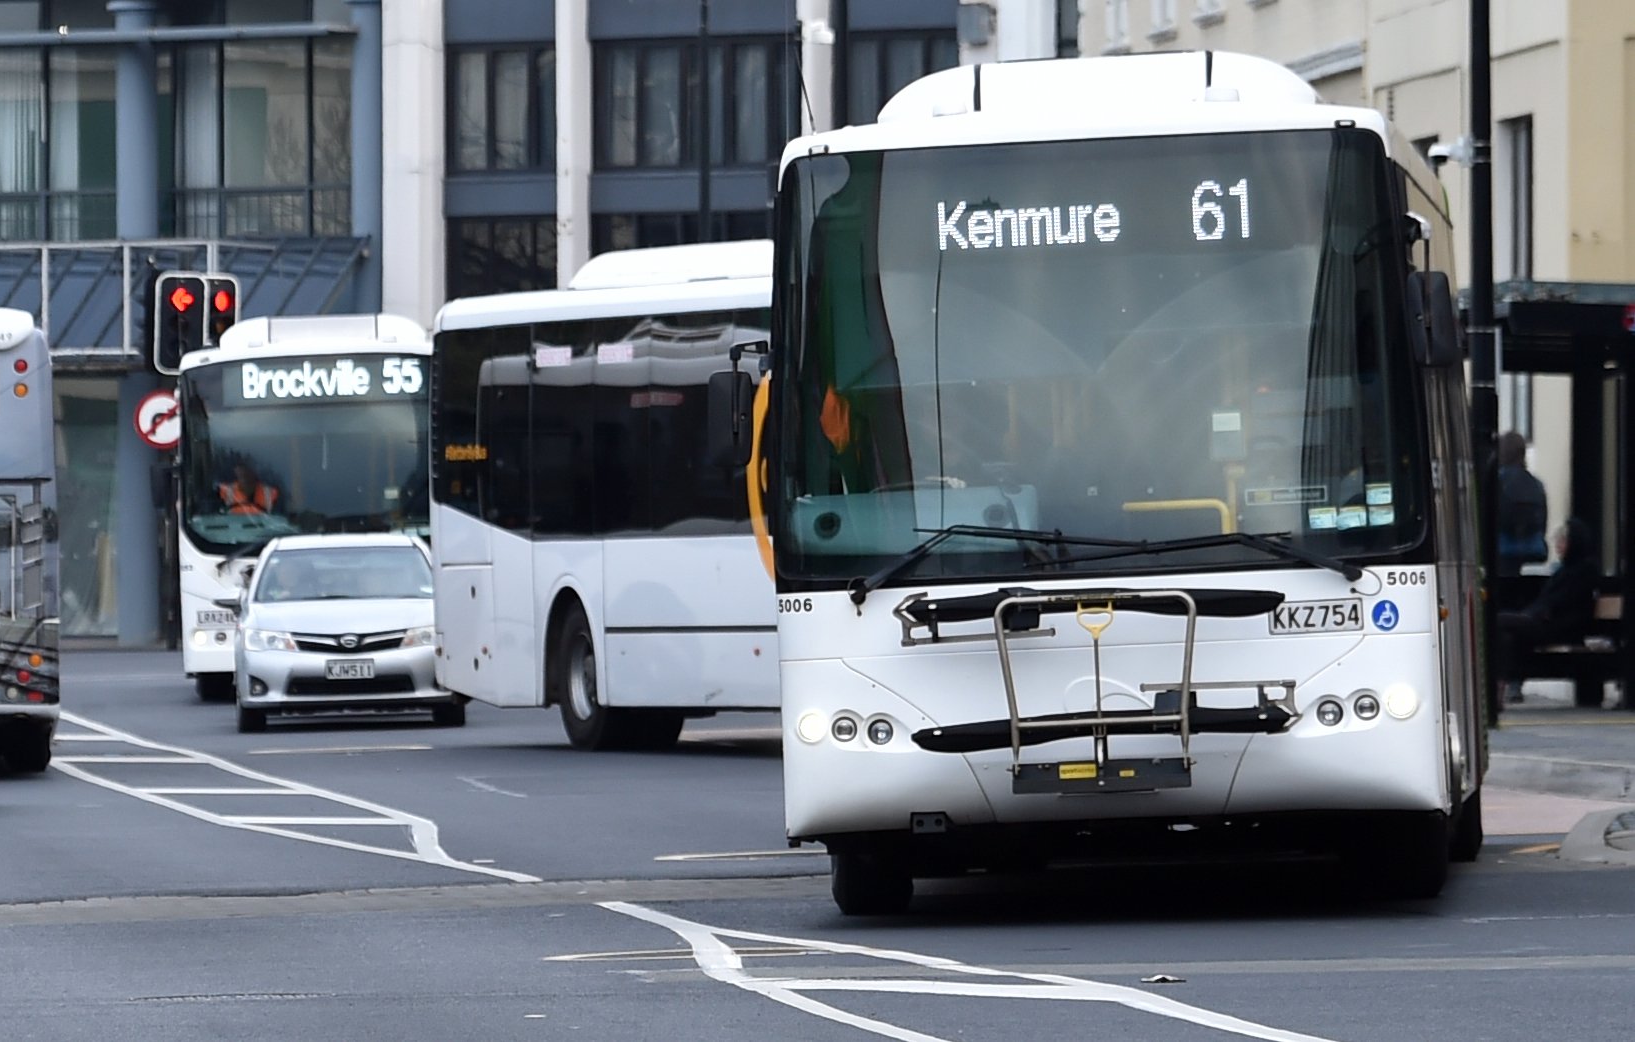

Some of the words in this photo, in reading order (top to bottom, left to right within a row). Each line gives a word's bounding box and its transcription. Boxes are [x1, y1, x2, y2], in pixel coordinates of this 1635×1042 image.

[937, 201, 1121, 251] Kenmure
[1191, 178, 1250, 241] 61
[242, 359, 370, 399] Brockville
[381, 358, 424, 394] 55
[1386, 571, 1426, 586] 5006
[778, 598, 813, 613] 5006
[1273, 604, 1360, 630] KKZ754
